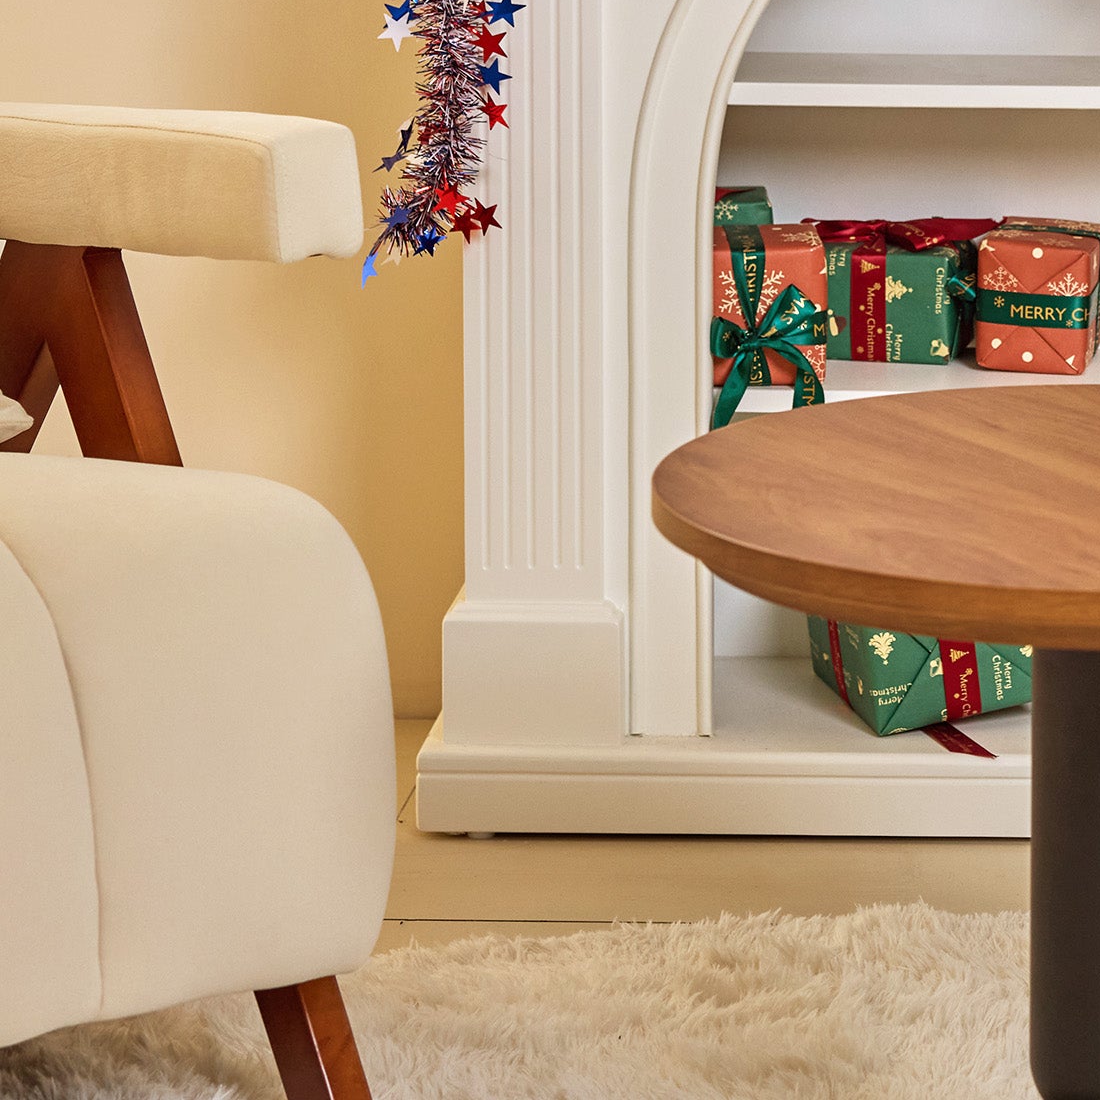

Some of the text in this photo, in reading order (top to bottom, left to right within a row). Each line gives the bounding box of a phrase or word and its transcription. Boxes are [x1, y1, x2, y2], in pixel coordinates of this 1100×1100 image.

[865, 287, 877, 317] Merry
[935, 267, 946, 315] Christmas
[1010, 304, 1067, 321] MERRY
[893, 334, 904, 362] Merry
[959, 672, 970, 702] Merry
[992, 654, 1004, 701] Christmas
[1003, 661, 1013, 690] Merry
